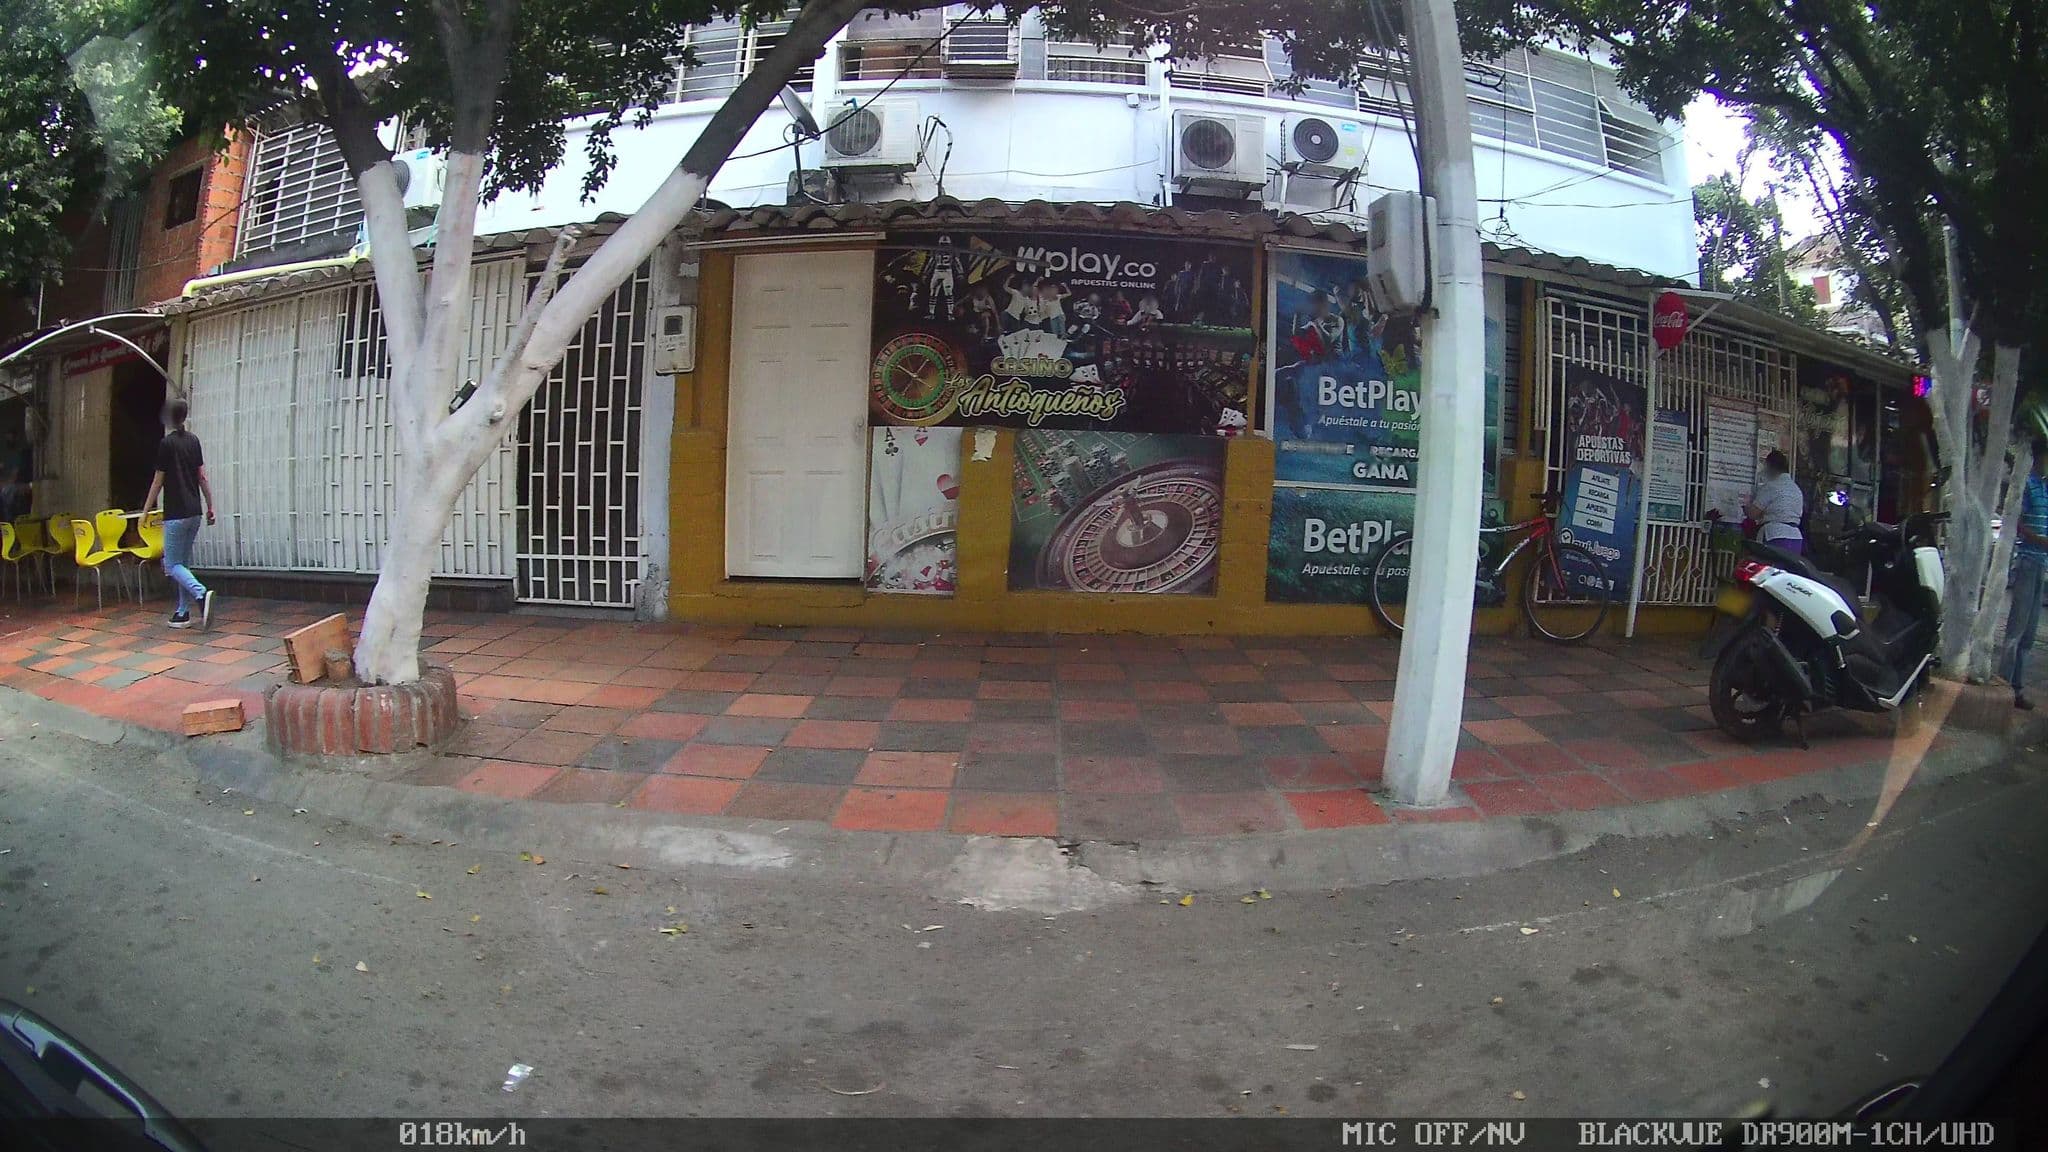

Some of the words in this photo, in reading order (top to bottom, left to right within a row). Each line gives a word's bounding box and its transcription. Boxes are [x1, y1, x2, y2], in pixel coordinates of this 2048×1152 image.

[1071, 278, 1118, 287] APUESTAS
[1119, 281, 1156, 289] ONLINE
[958, 374, 1126, 426] Antioqueños
[1318, 376, 1422, 420] BetPlay
[1318, 413, 1368, 427] Apuéstale
[1370, 419, 1377, 428] a
[1379, 418, 1389, 429] tu
[1391, 420, 1420, 432] pasió
[1578, 434, 1627, 451] APUESTAS
[1369, 445, 1420, 459] RECARG
[1576, 448, 1632, 464] DEPORTIVAS
[1353, 462, 1409, 480] GANA
